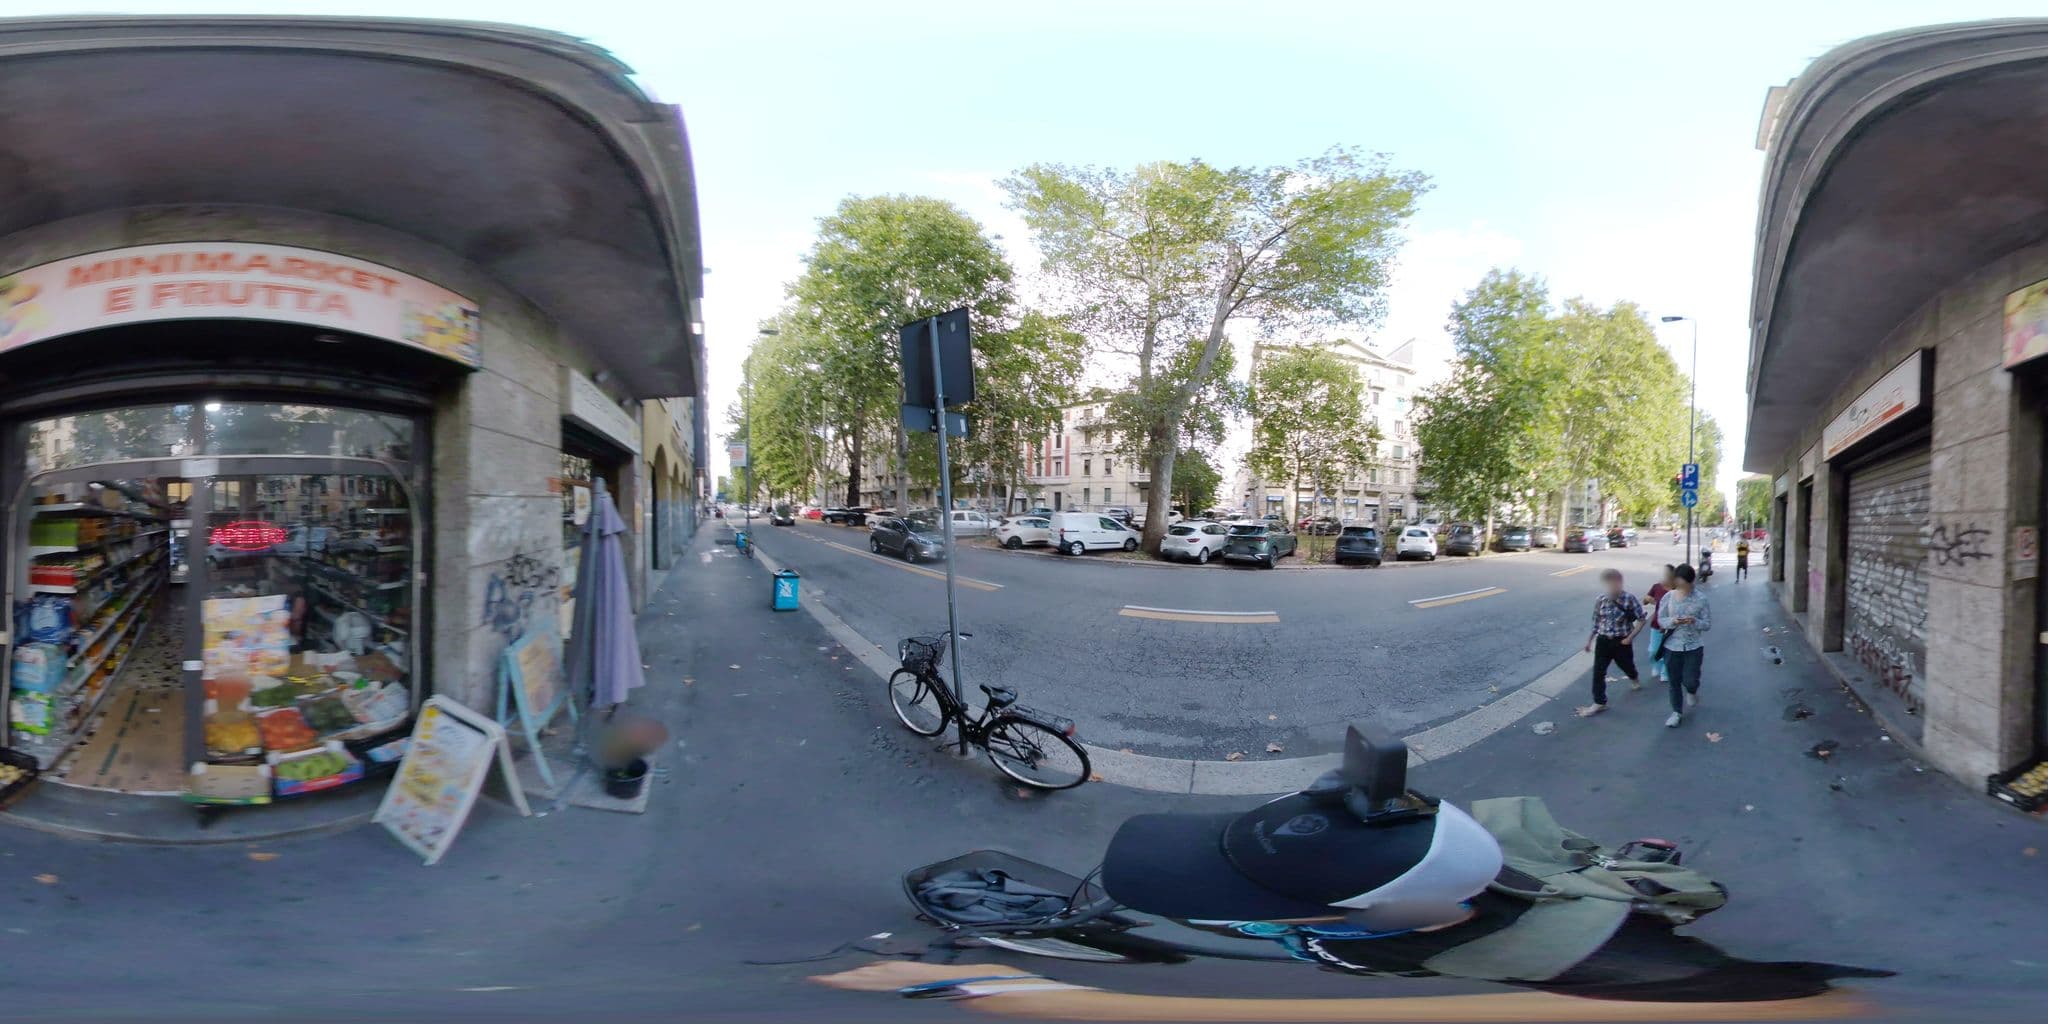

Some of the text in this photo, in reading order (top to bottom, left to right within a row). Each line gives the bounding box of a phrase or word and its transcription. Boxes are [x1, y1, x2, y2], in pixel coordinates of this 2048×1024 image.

[103, 279, 353, 318] E FRUTTA
[1685, 465, 1696, 478] P
[209, 528, 288, 544] APERTO
